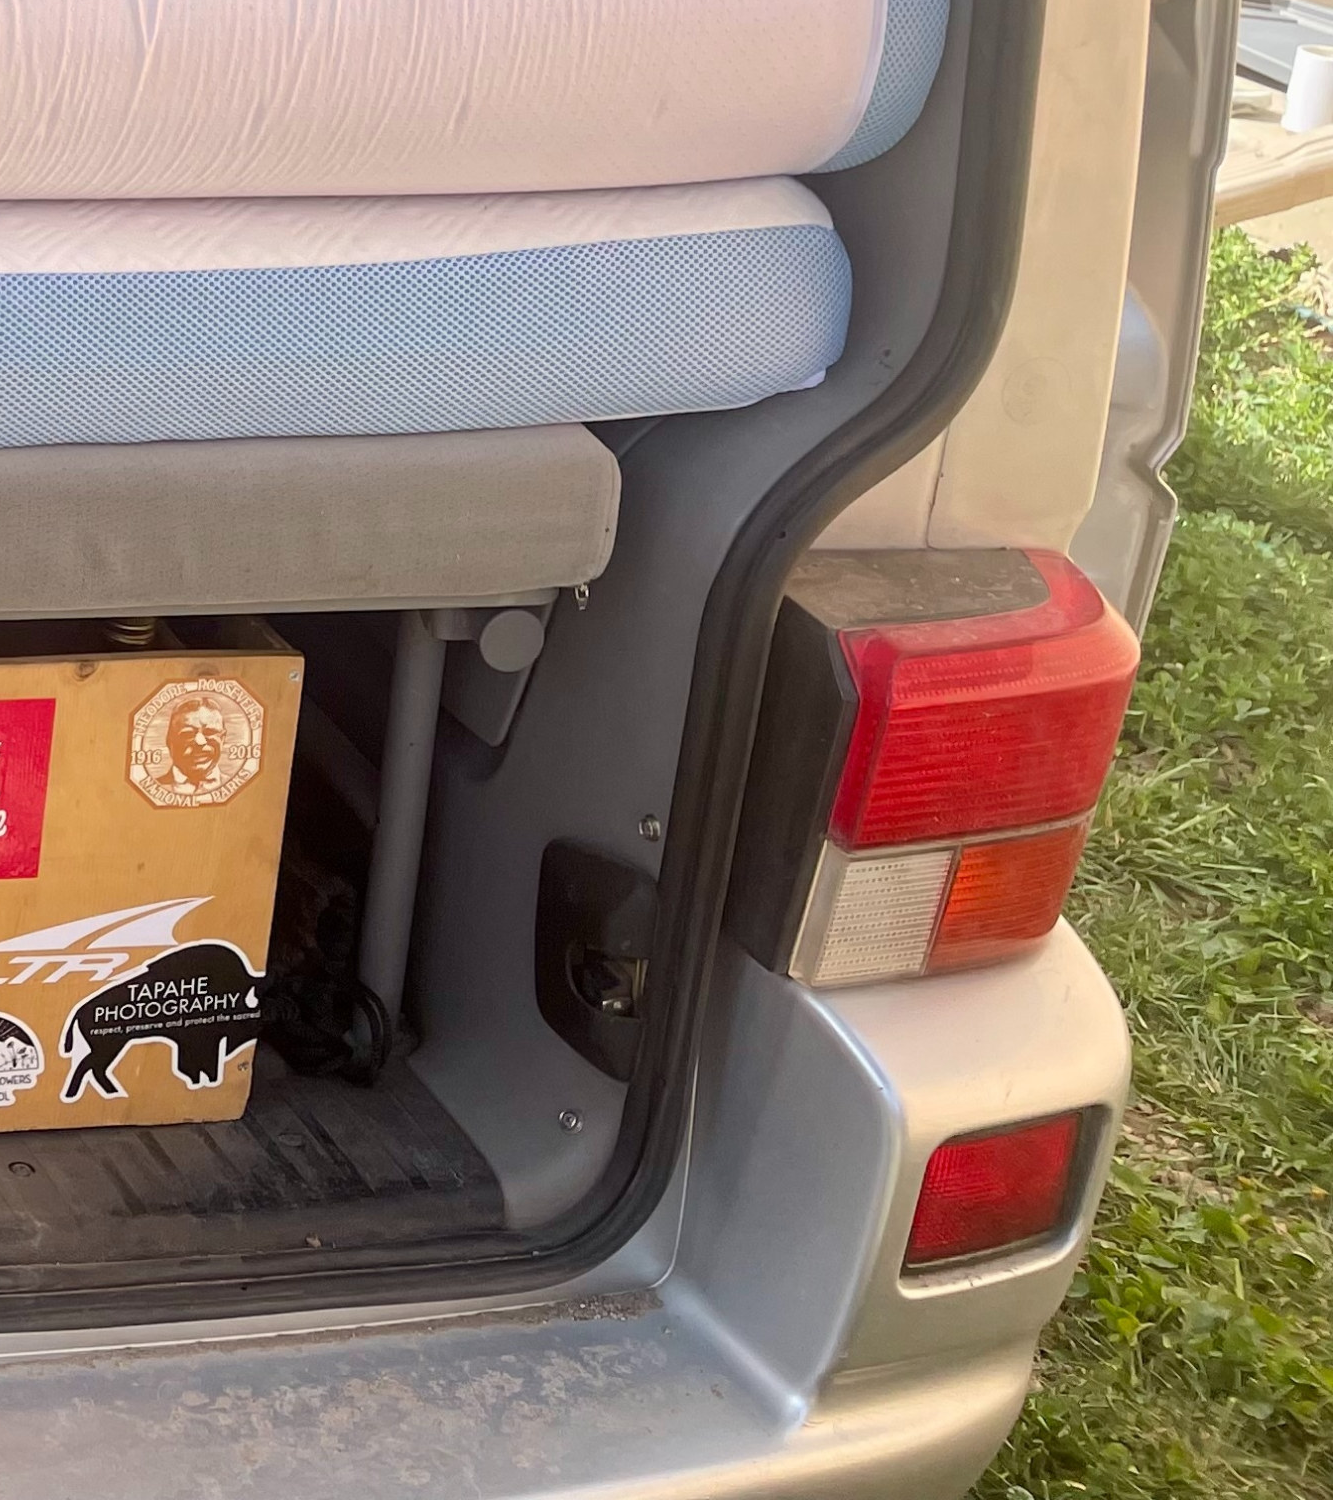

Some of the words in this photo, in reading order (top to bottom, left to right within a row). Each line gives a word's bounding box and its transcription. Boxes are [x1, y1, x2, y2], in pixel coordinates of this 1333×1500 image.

[132, 682, 187, 737] THEODORE
[131, 749, 162, 766] 1916
[228, 745, 261, 760] 2016
[139, 775, 200, 807] NATIONAL
[212, 769, 251, 801] PARKS
[128, 976, 208, 1002] TAPAHE
[94, 992, 240, 1023] PHOTOGRAPHY
[126, 1022, 163, 1033] preserve
[166, 1018, 183, 1028] and
[184, 1015, 215, 1028] protect
[216, 1013, 230, 1022] the
[233, 1010, 261, 1021] sacred
